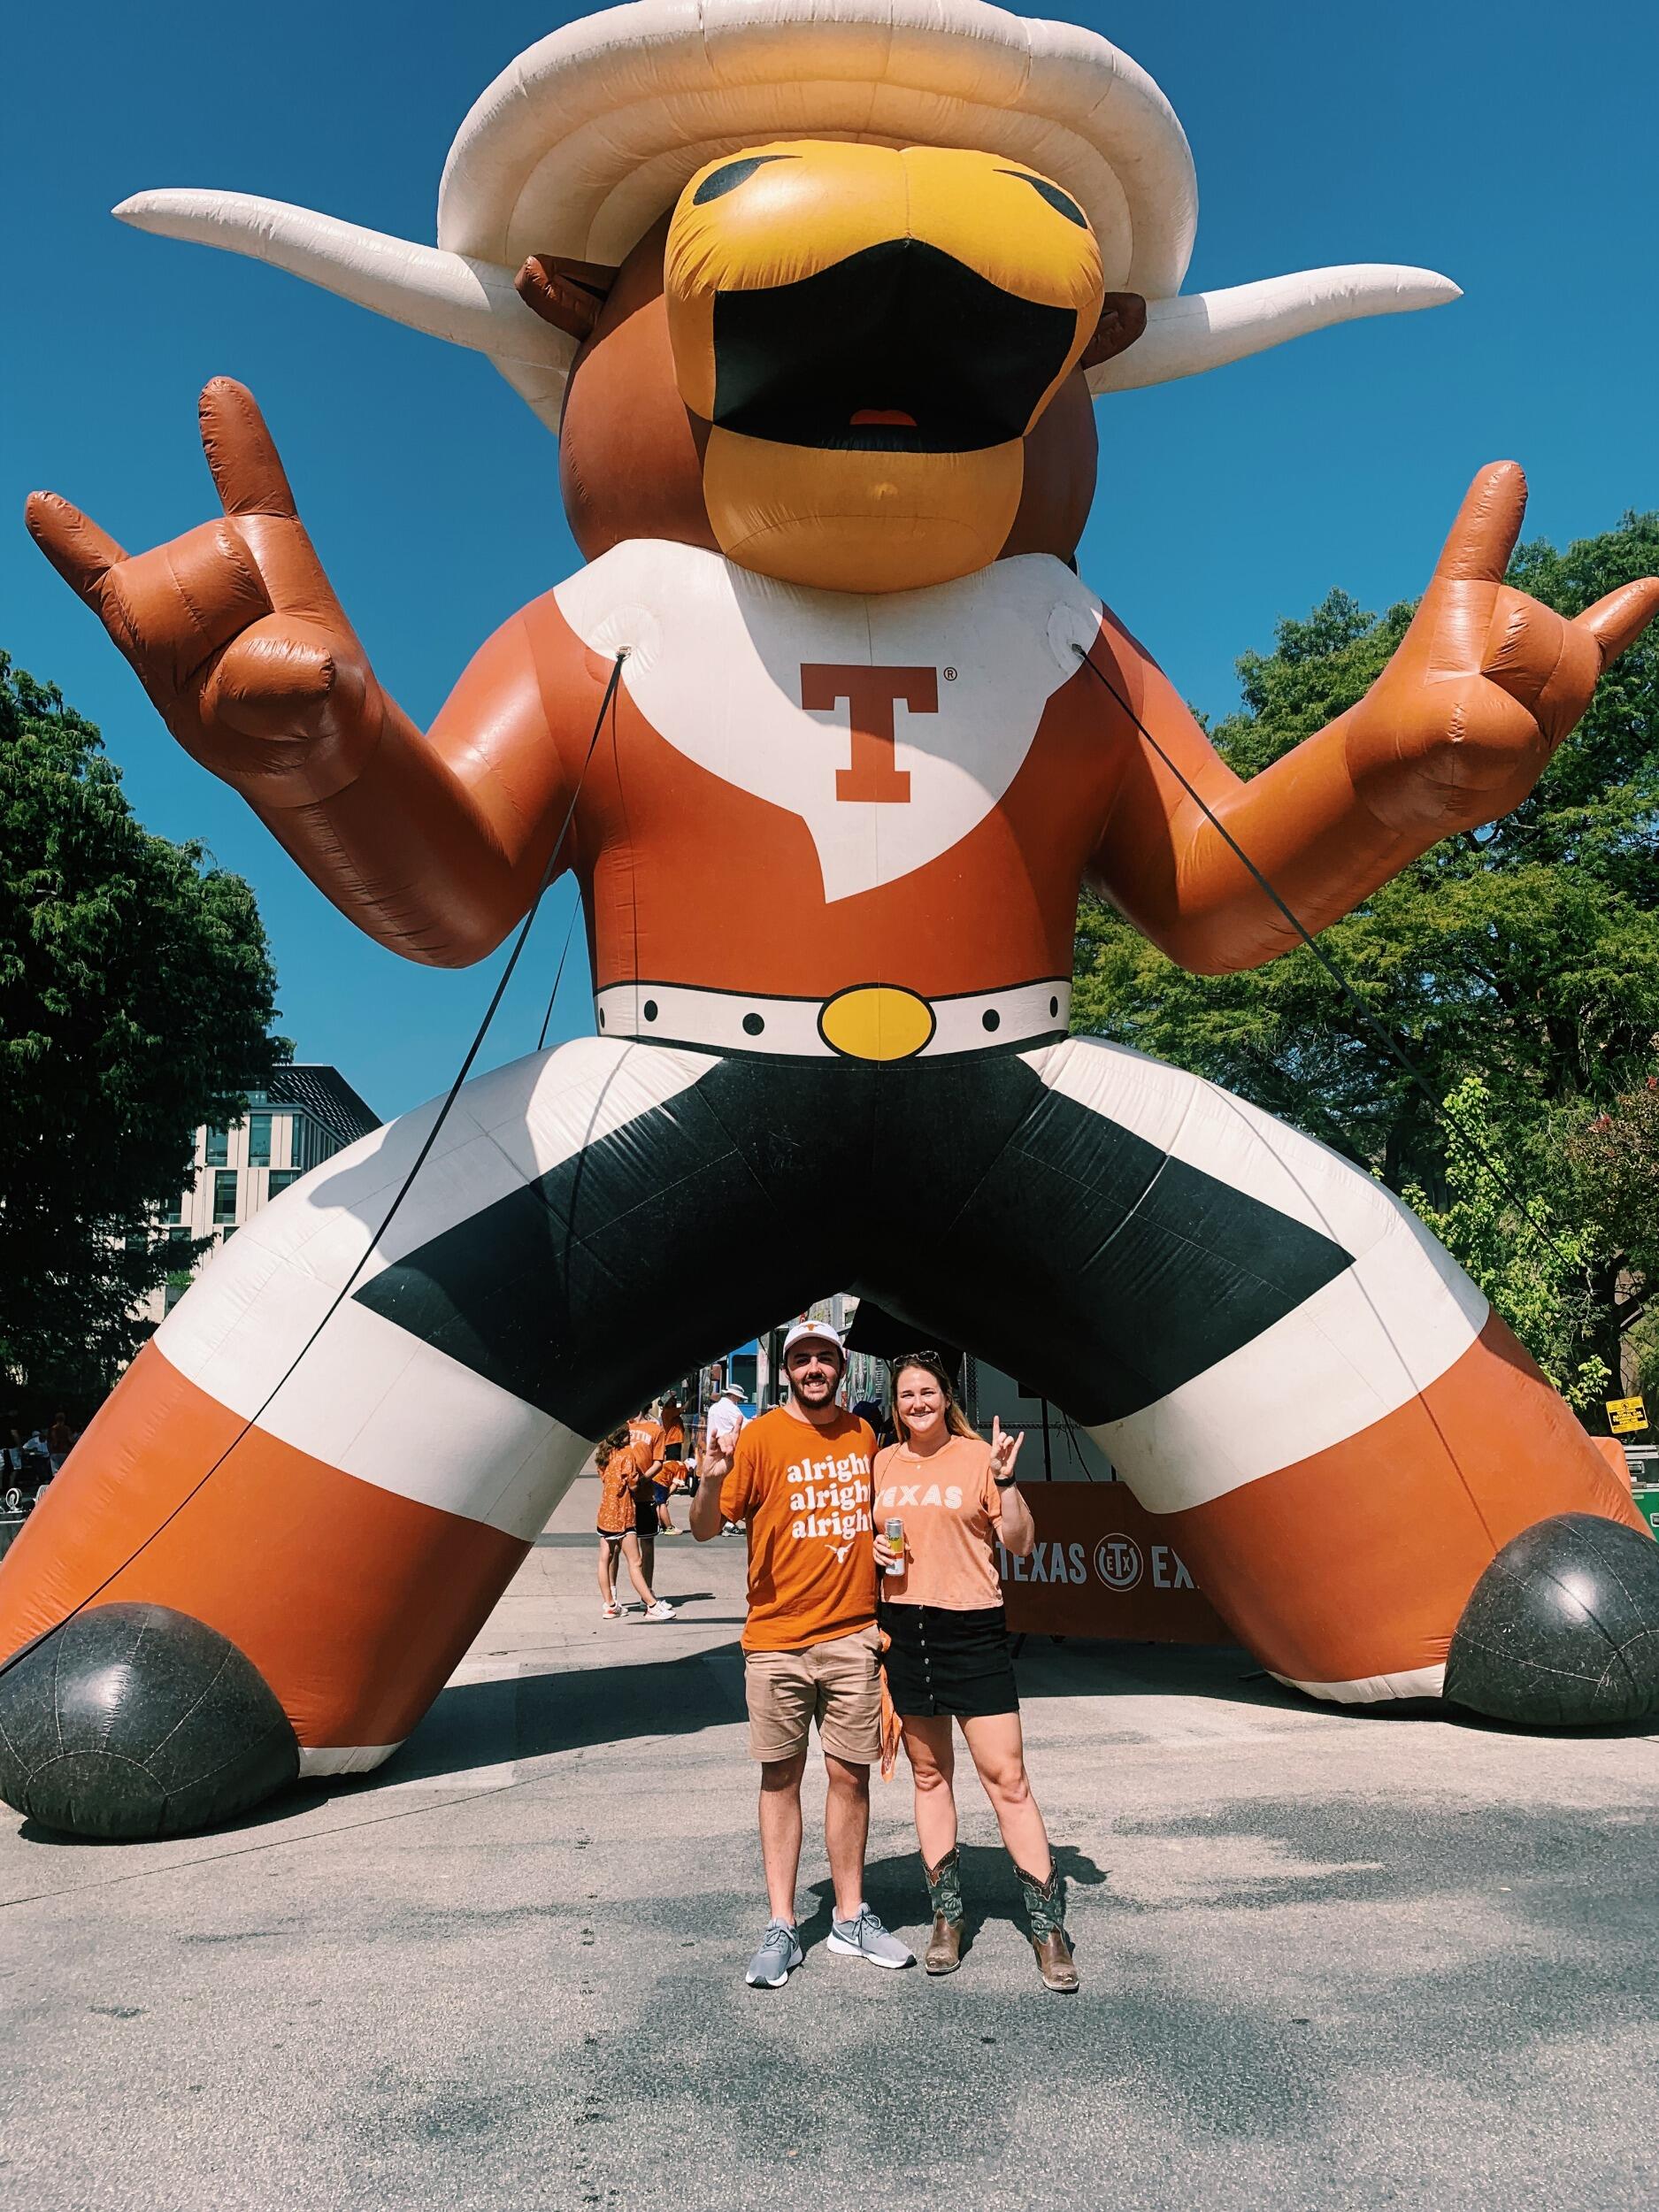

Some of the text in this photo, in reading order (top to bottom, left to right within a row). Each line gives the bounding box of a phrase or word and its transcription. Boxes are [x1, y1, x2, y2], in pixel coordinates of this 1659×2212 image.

[800, 663, 939, 803] T
[790, 1479, 871, 1511] alrigh
[995, 1541, 1087, 1585] TEXAS
[1151, 1546, 1201, 1589] EX
